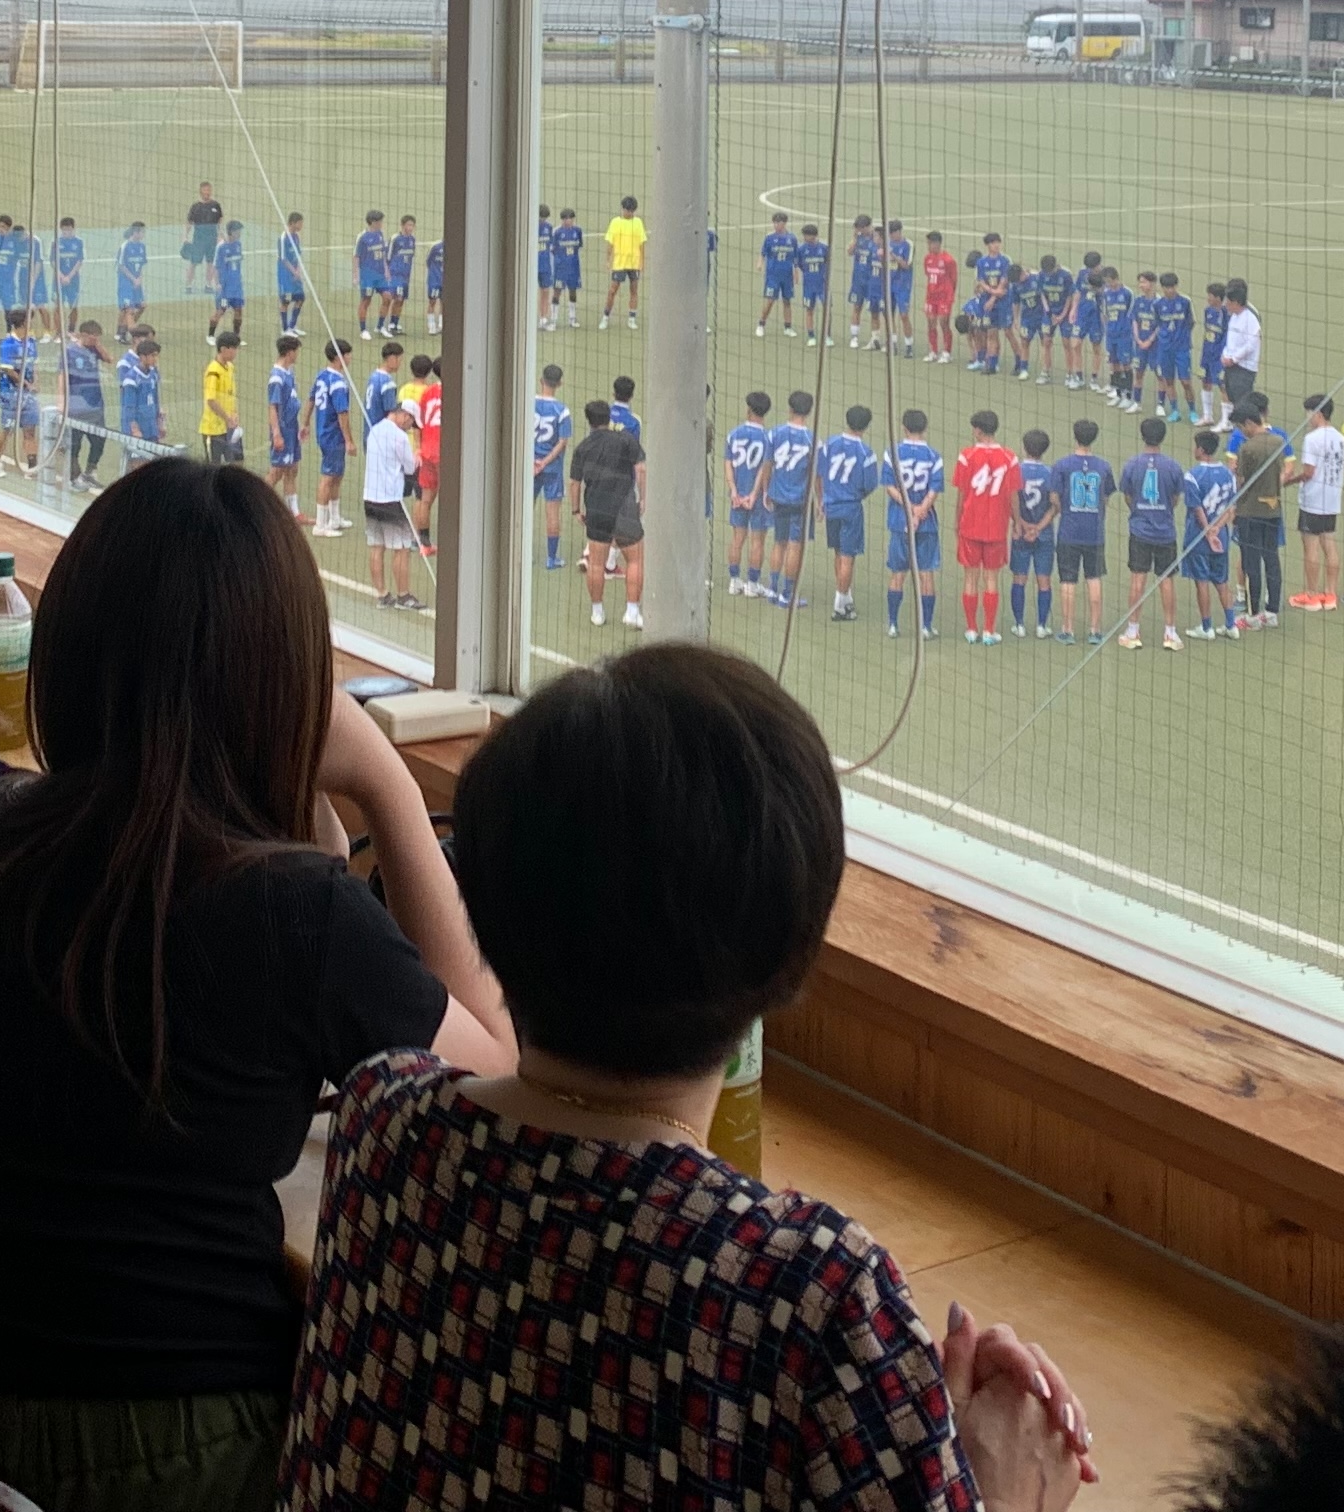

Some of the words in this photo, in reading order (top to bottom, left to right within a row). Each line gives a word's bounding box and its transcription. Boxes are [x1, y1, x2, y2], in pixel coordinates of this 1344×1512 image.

[731, 439, 763, 470] 50
[773, 440, 809, 471] 47
[971, 463, 1008, 497] 41
[1024, 479, 1046, 511] 5
